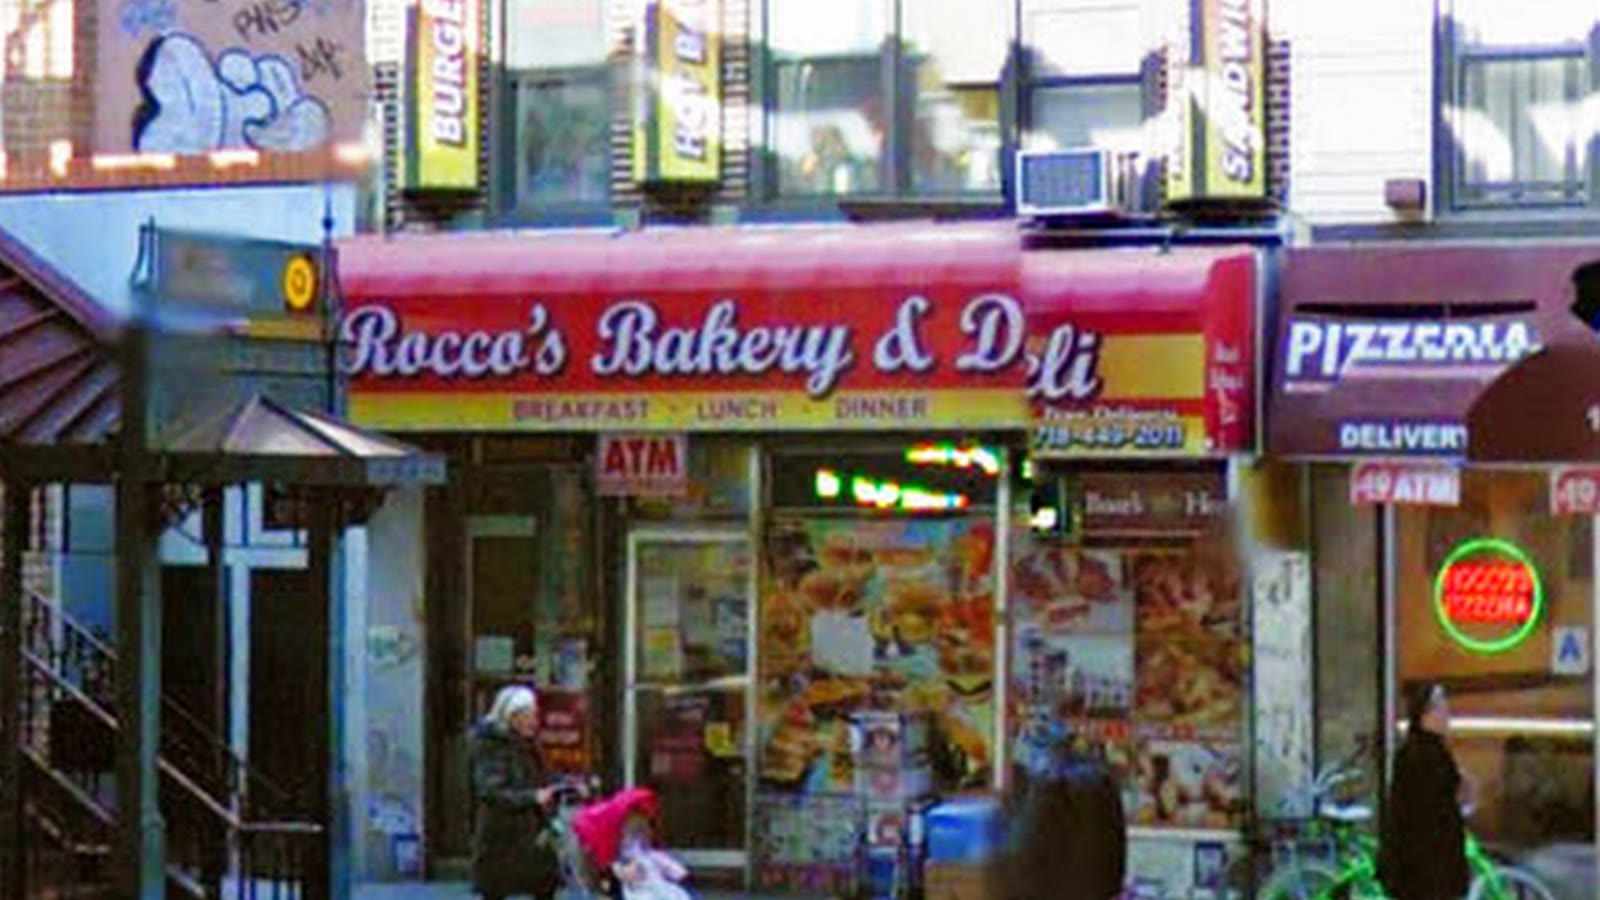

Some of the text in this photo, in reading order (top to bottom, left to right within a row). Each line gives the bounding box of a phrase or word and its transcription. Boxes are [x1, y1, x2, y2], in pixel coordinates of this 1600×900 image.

[342, 292, 1100, 398] Rocco's Bakery & Dli
[1284, 319, 1537, 377] PIZZERIA
[511, 397, 928, 420] BREAKFAST LUNCH DINNER
[604, 438, 678, 477] ATM
[1557, 632, 1582, 663] A
